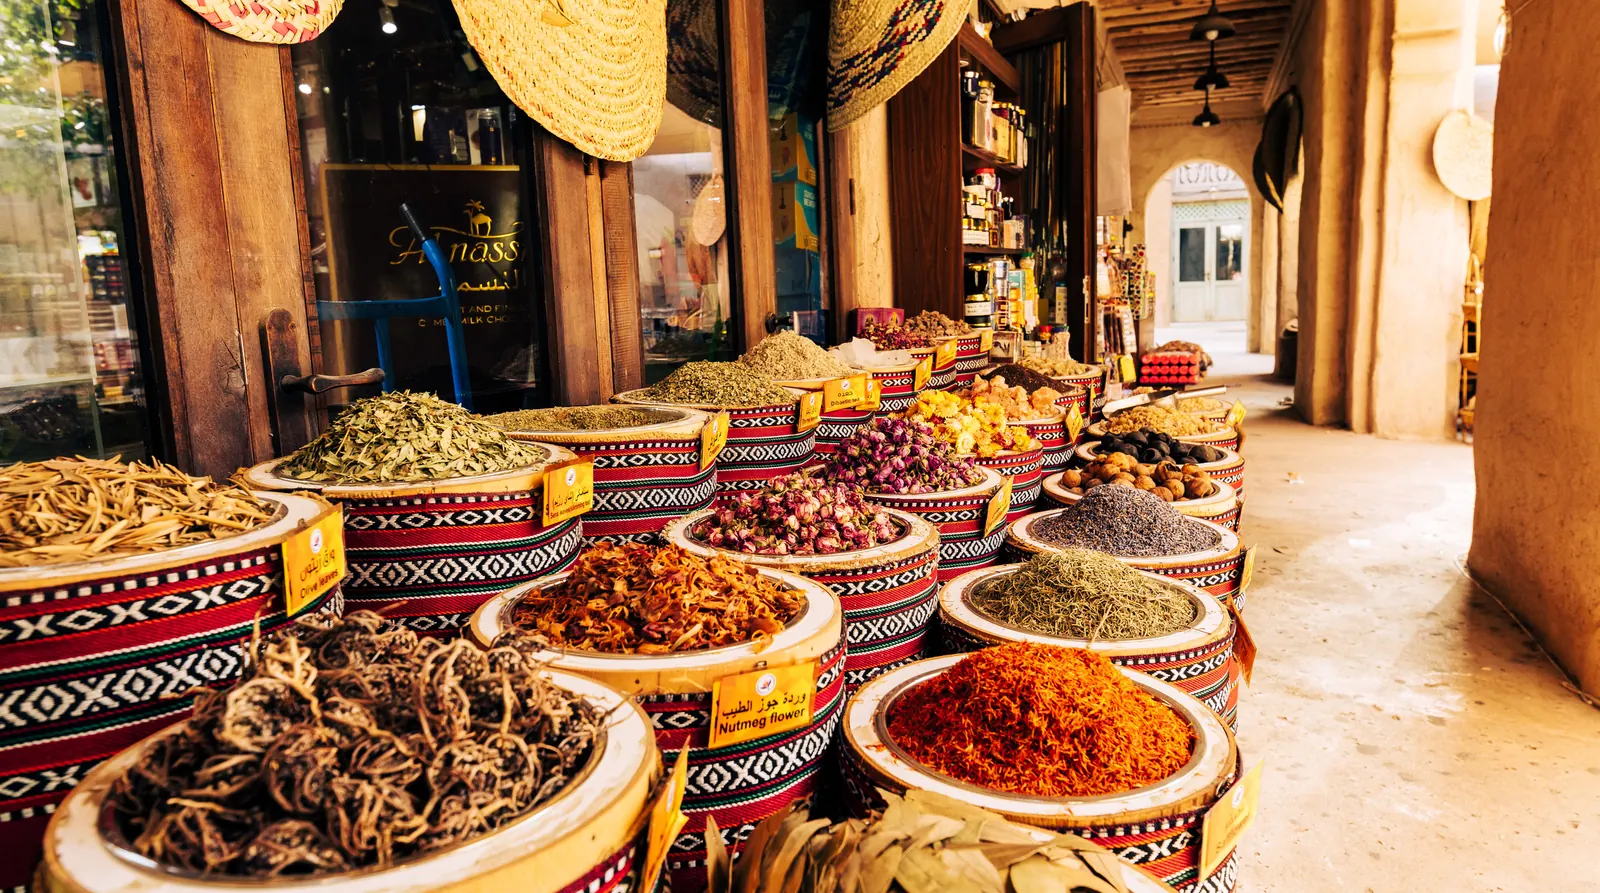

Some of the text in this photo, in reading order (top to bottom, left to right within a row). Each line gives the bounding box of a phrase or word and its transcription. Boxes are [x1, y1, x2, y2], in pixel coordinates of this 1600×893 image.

[300, 568, 339, 599] Olive leaves
[722, 692, 806, 720] وردة جوز الطيب
[719, 708, 805, 735] Nutmeg flower
